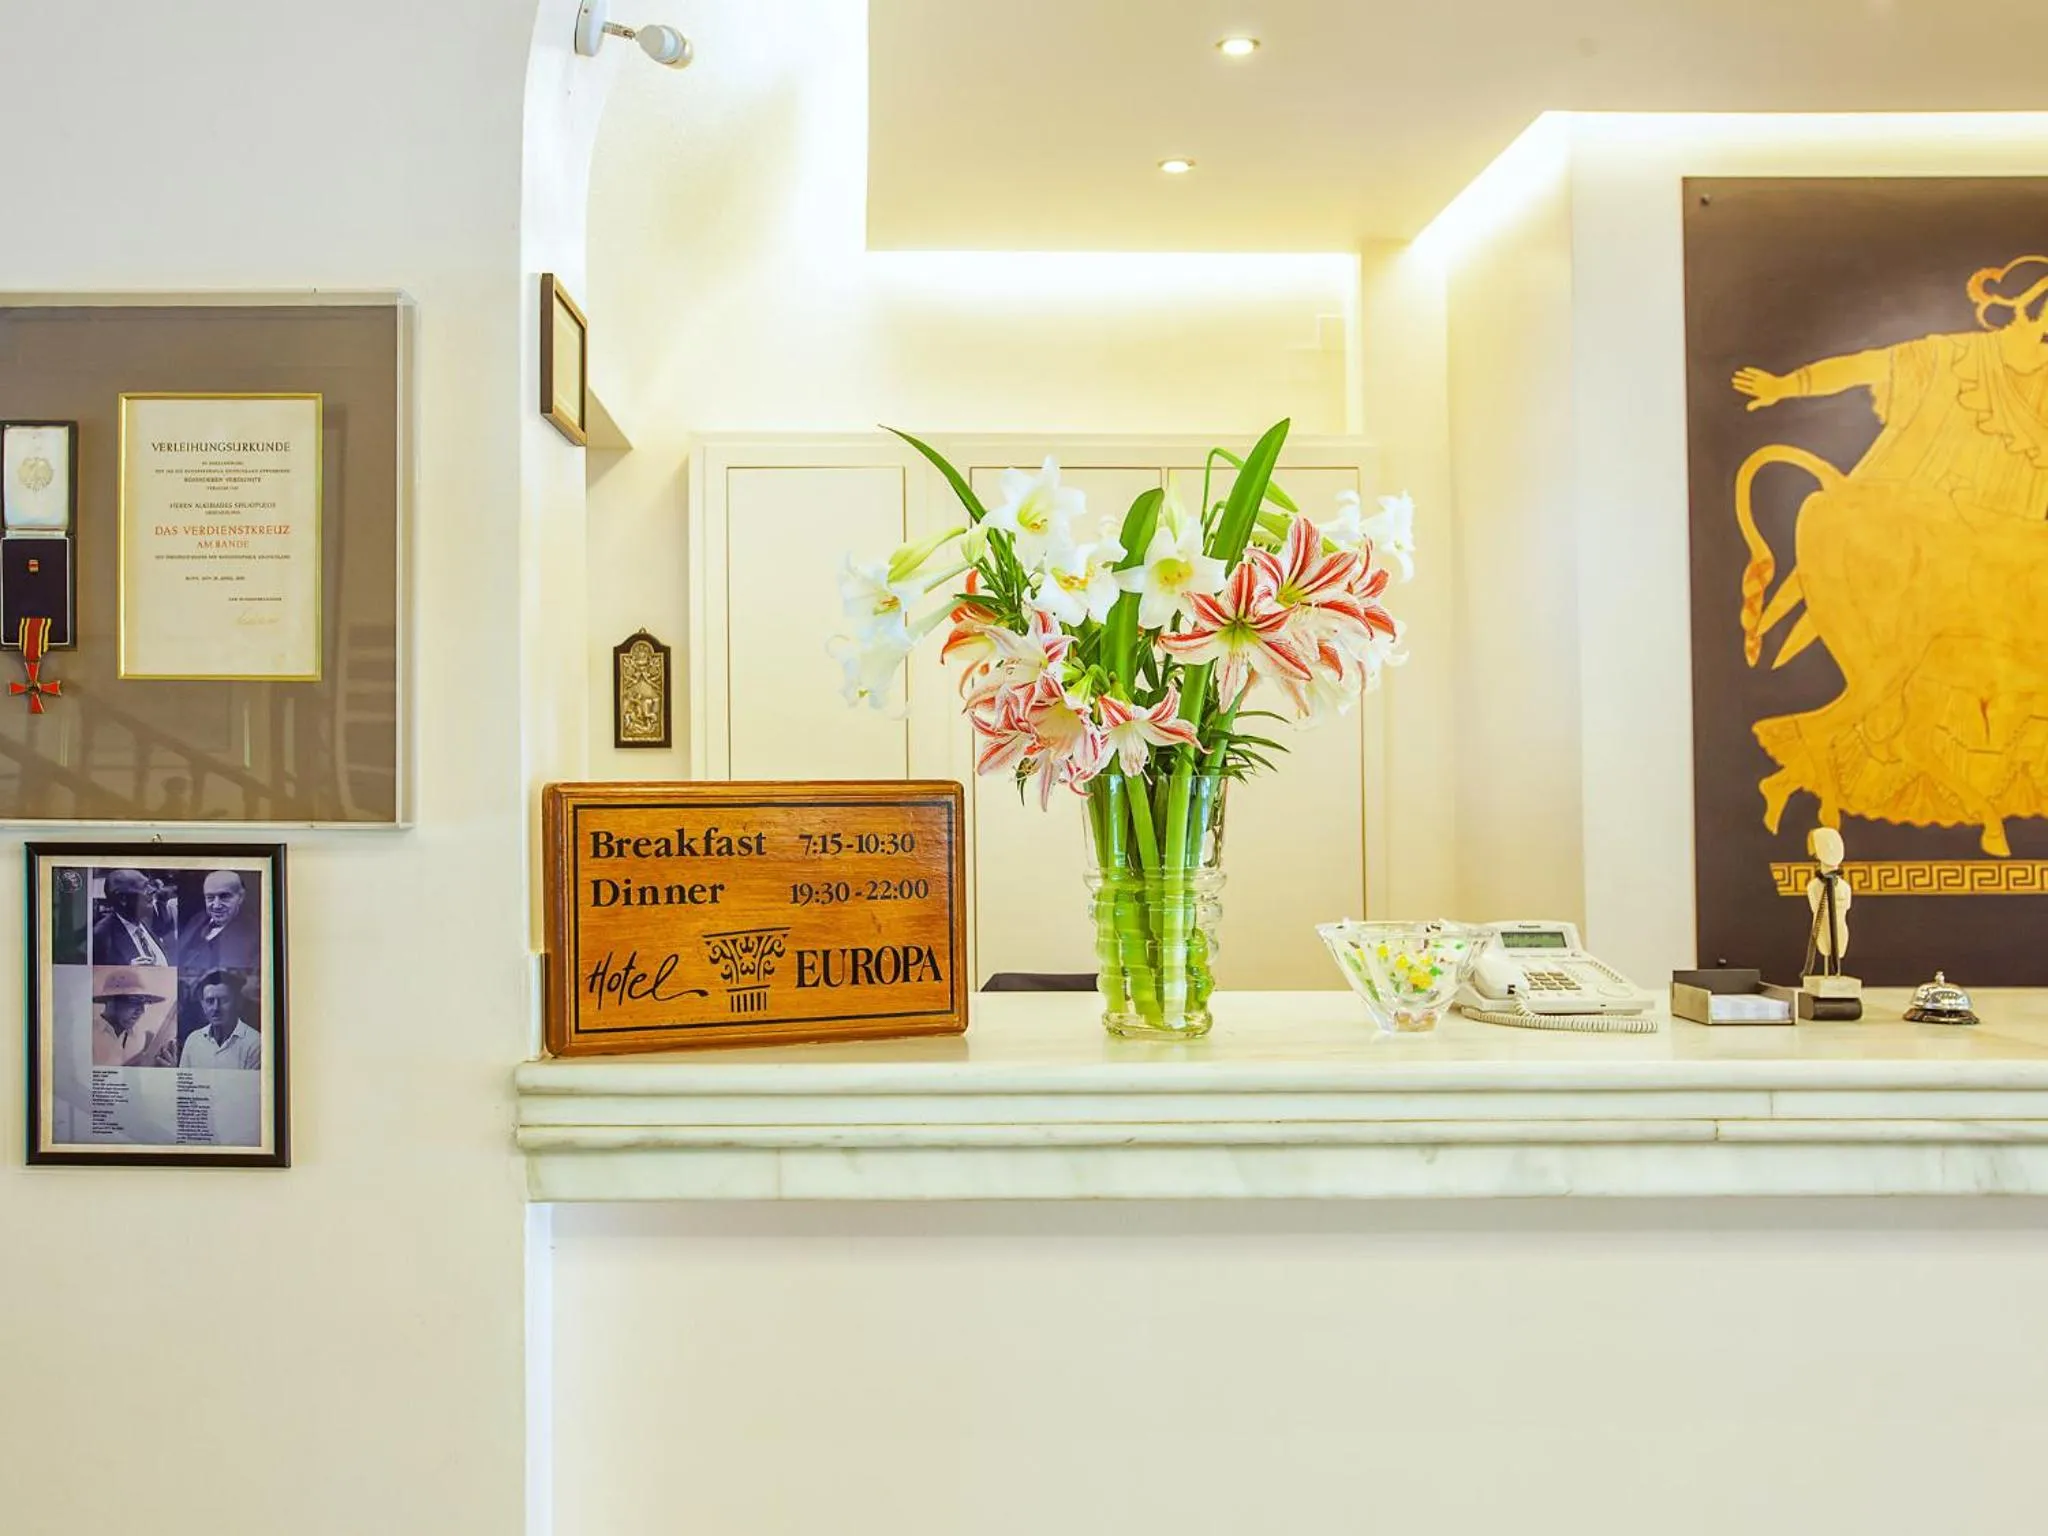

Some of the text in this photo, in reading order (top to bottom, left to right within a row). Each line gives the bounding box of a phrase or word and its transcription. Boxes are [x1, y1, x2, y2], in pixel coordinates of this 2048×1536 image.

[151, 441, 291, 452] VERLEIHUNGSURKUNDE
[154, 525, 291, 536] DAS VERDIENSTKREUZ
[590, 827, 915, 859] Breakfast 7:15-10:30
[590, 878, 725, 908] Dinner
[586, 945, 943, 1011] Hotel EUROPA
